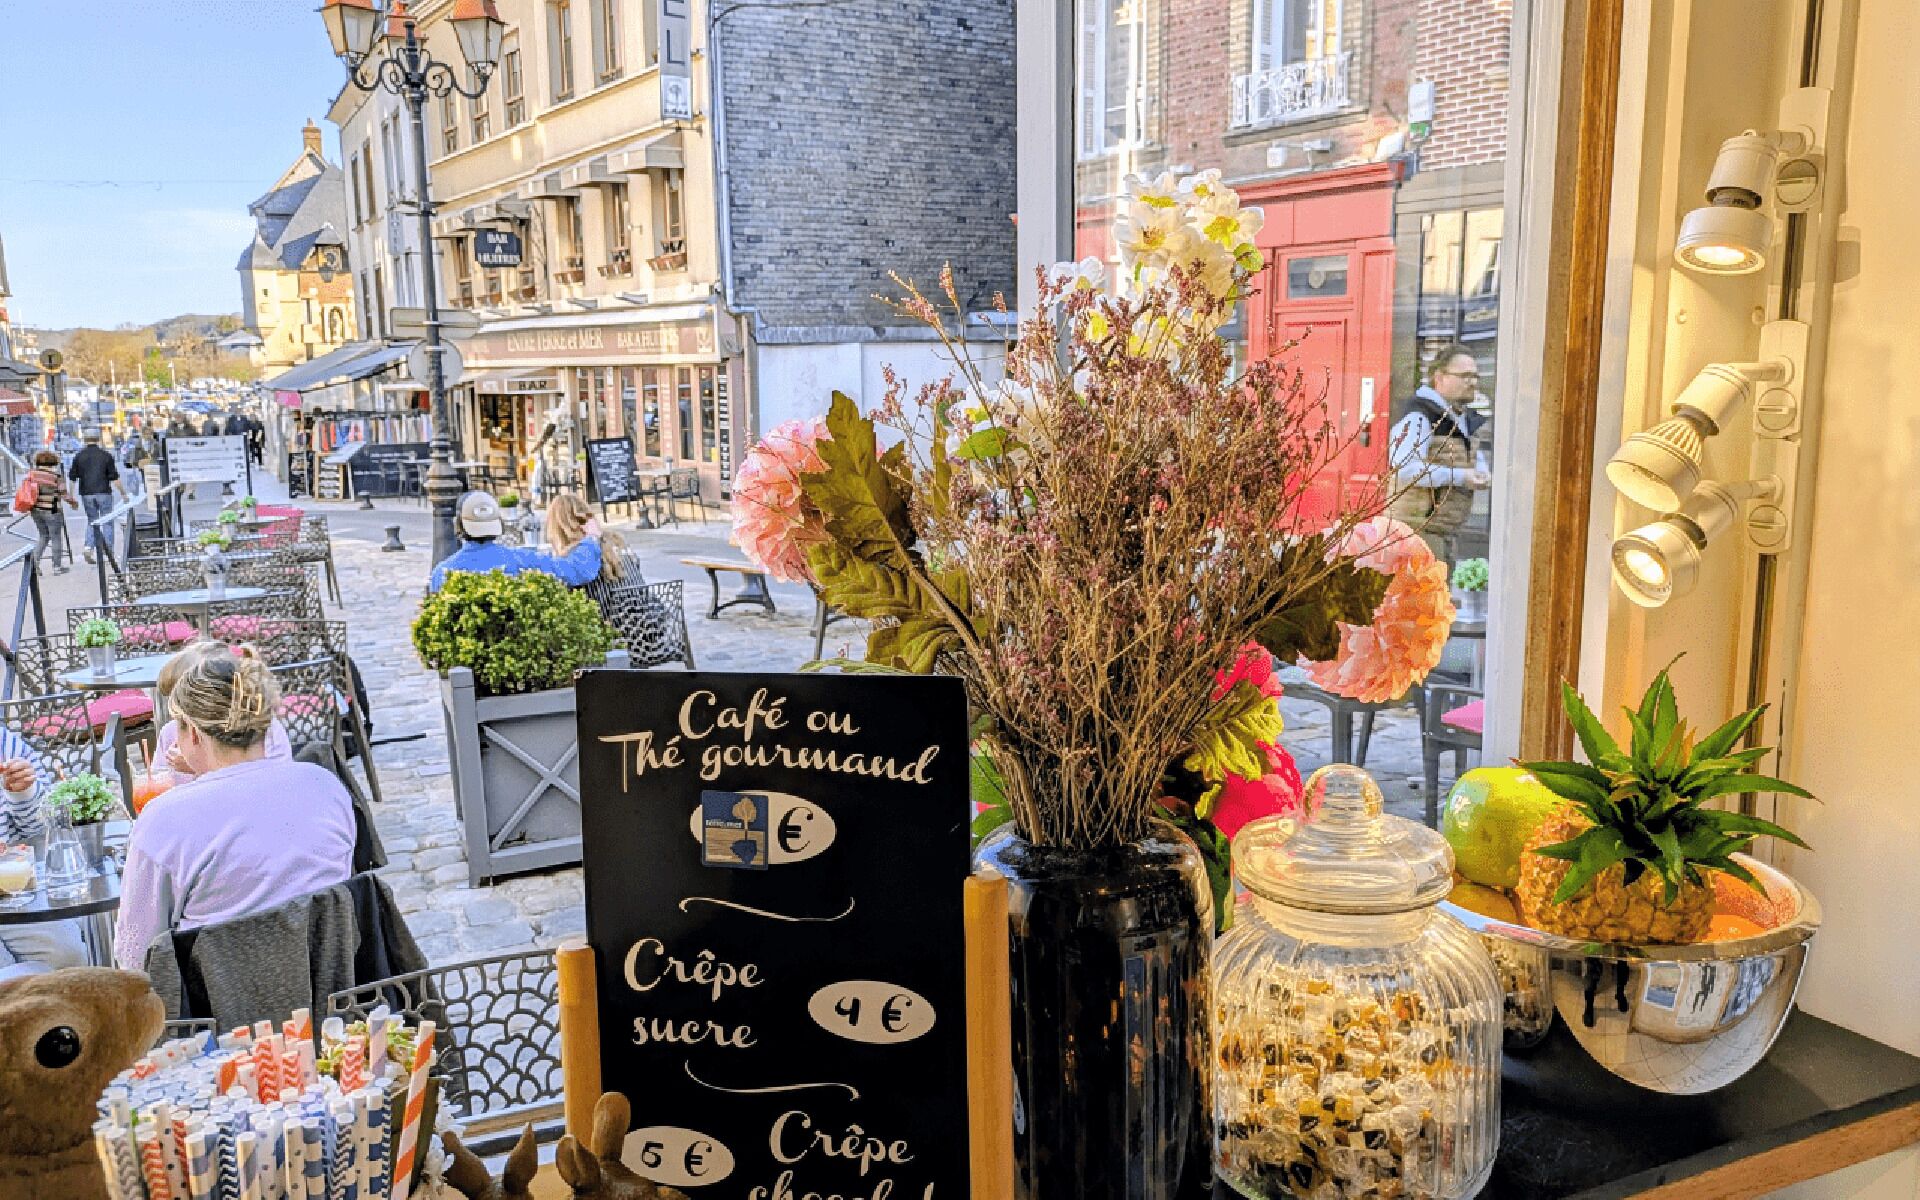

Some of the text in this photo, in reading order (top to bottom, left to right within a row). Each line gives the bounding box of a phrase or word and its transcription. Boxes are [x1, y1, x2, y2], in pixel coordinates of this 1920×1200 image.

[486, 231, 509, 244] BAR
[518, 380, 547, 391] BAR
[679, 688, 861, 741] Café ou
[598, 731, 940, 792] Thé gourmand
[624, 938, 765, 1002] Crêpe
[632, 1016, 758, 1048] sucre
[834, 993, 912, 1033] 4 €
[641, 1140, 713, 1177] 5 €
[769, 1110, 916, 1177] Crêpe
